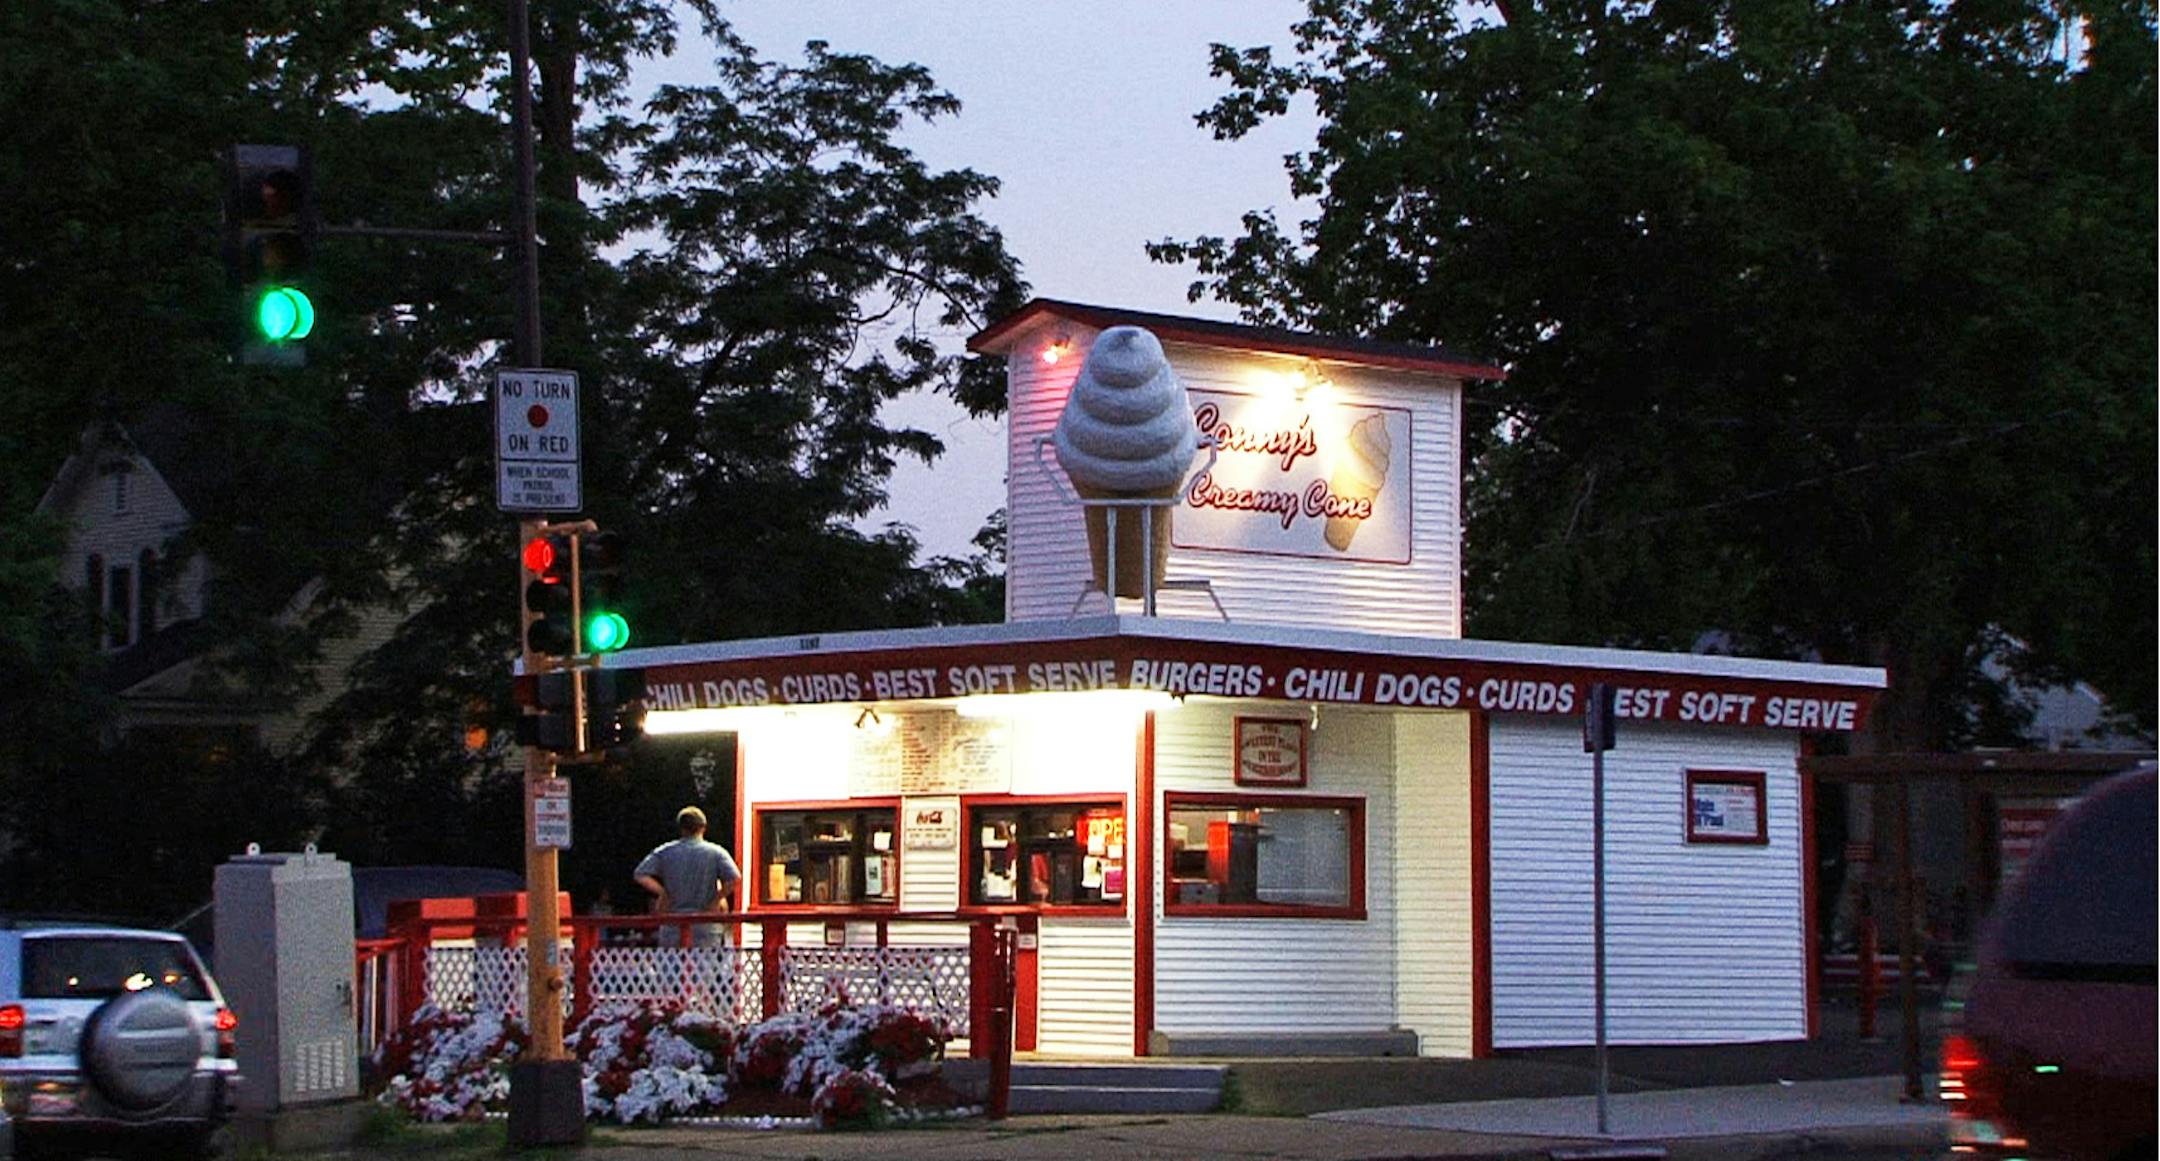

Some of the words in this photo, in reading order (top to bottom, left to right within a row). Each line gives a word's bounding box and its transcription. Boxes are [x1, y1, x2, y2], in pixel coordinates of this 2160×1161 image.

[502, 380, 522, 398] NO
[534, 380, 571, 400] TURN
[508, 434, 529, 452] ON
[539, 436, 569, 453] RED
[1195, 402, 1318, 472] Conny's
[507, 465, 532, 479] WHEN
[536, 466, 570, 479] SCHOOL
[1188, 472, 1299, 530] Creamy
[1303, 479, 1373, 519] Cone
[703, 677, 769, 707] DOGS
[782, 672, 862, 704] CURDS
[873, 668, 937, 699] BEST
[949, 664, 1016, 696] SOFT
[1027, 660, 1118, 692] SERVE
[1131, 659, 1263, 696] BURGERS
[1284, 667, 1365, 701] CHILI
[1374, 673, 1461, 706] DOGS
[1479, 678, 1575, 713] CURDS
[1613, 688, 1671, 718] EST
[1678, 691, 1756, 724] SOFT
[1764, 696, 1859, 730] SERVE
[1088, 817, 1123, 845] OPE
